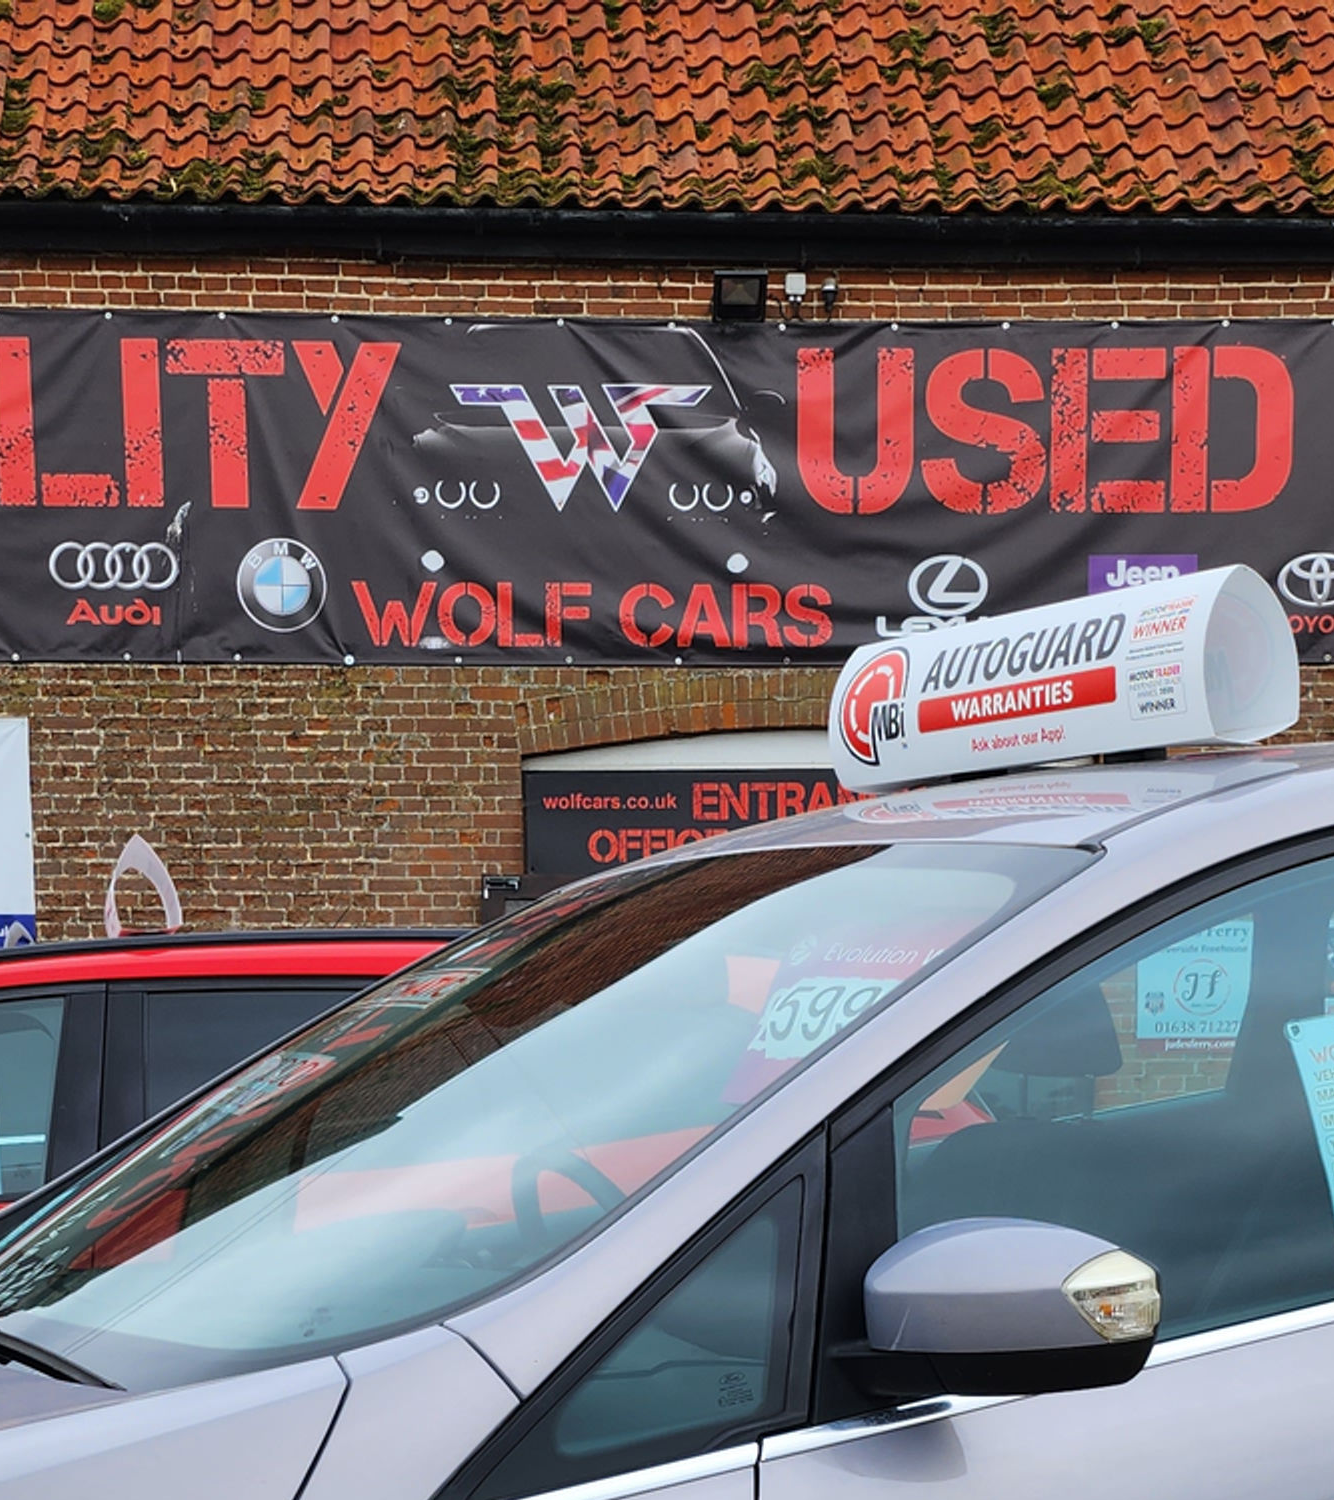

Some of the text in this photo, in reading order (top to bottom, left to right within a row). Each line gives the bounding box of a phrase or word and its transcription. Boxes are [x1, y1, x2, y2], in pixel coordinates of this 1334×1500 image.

[796, 347, 1294, 513] USED
[67, 599, 161, 626] Audi
[351, 580, 834, 648] WOLF CARS
[1132, 616, 1187, 639] WINNER
[921, 612, 1127, 693] AUTOGUARD
[952, 680, 1074, 721] WARRANTIES
[542, 791, 678, 811] wolfcars.co.uk
[692, 781, 879, 822] ENTRA
[823, 942, 919, 965] Evolution
[1154, 1020, 1196, 1034] 01638
